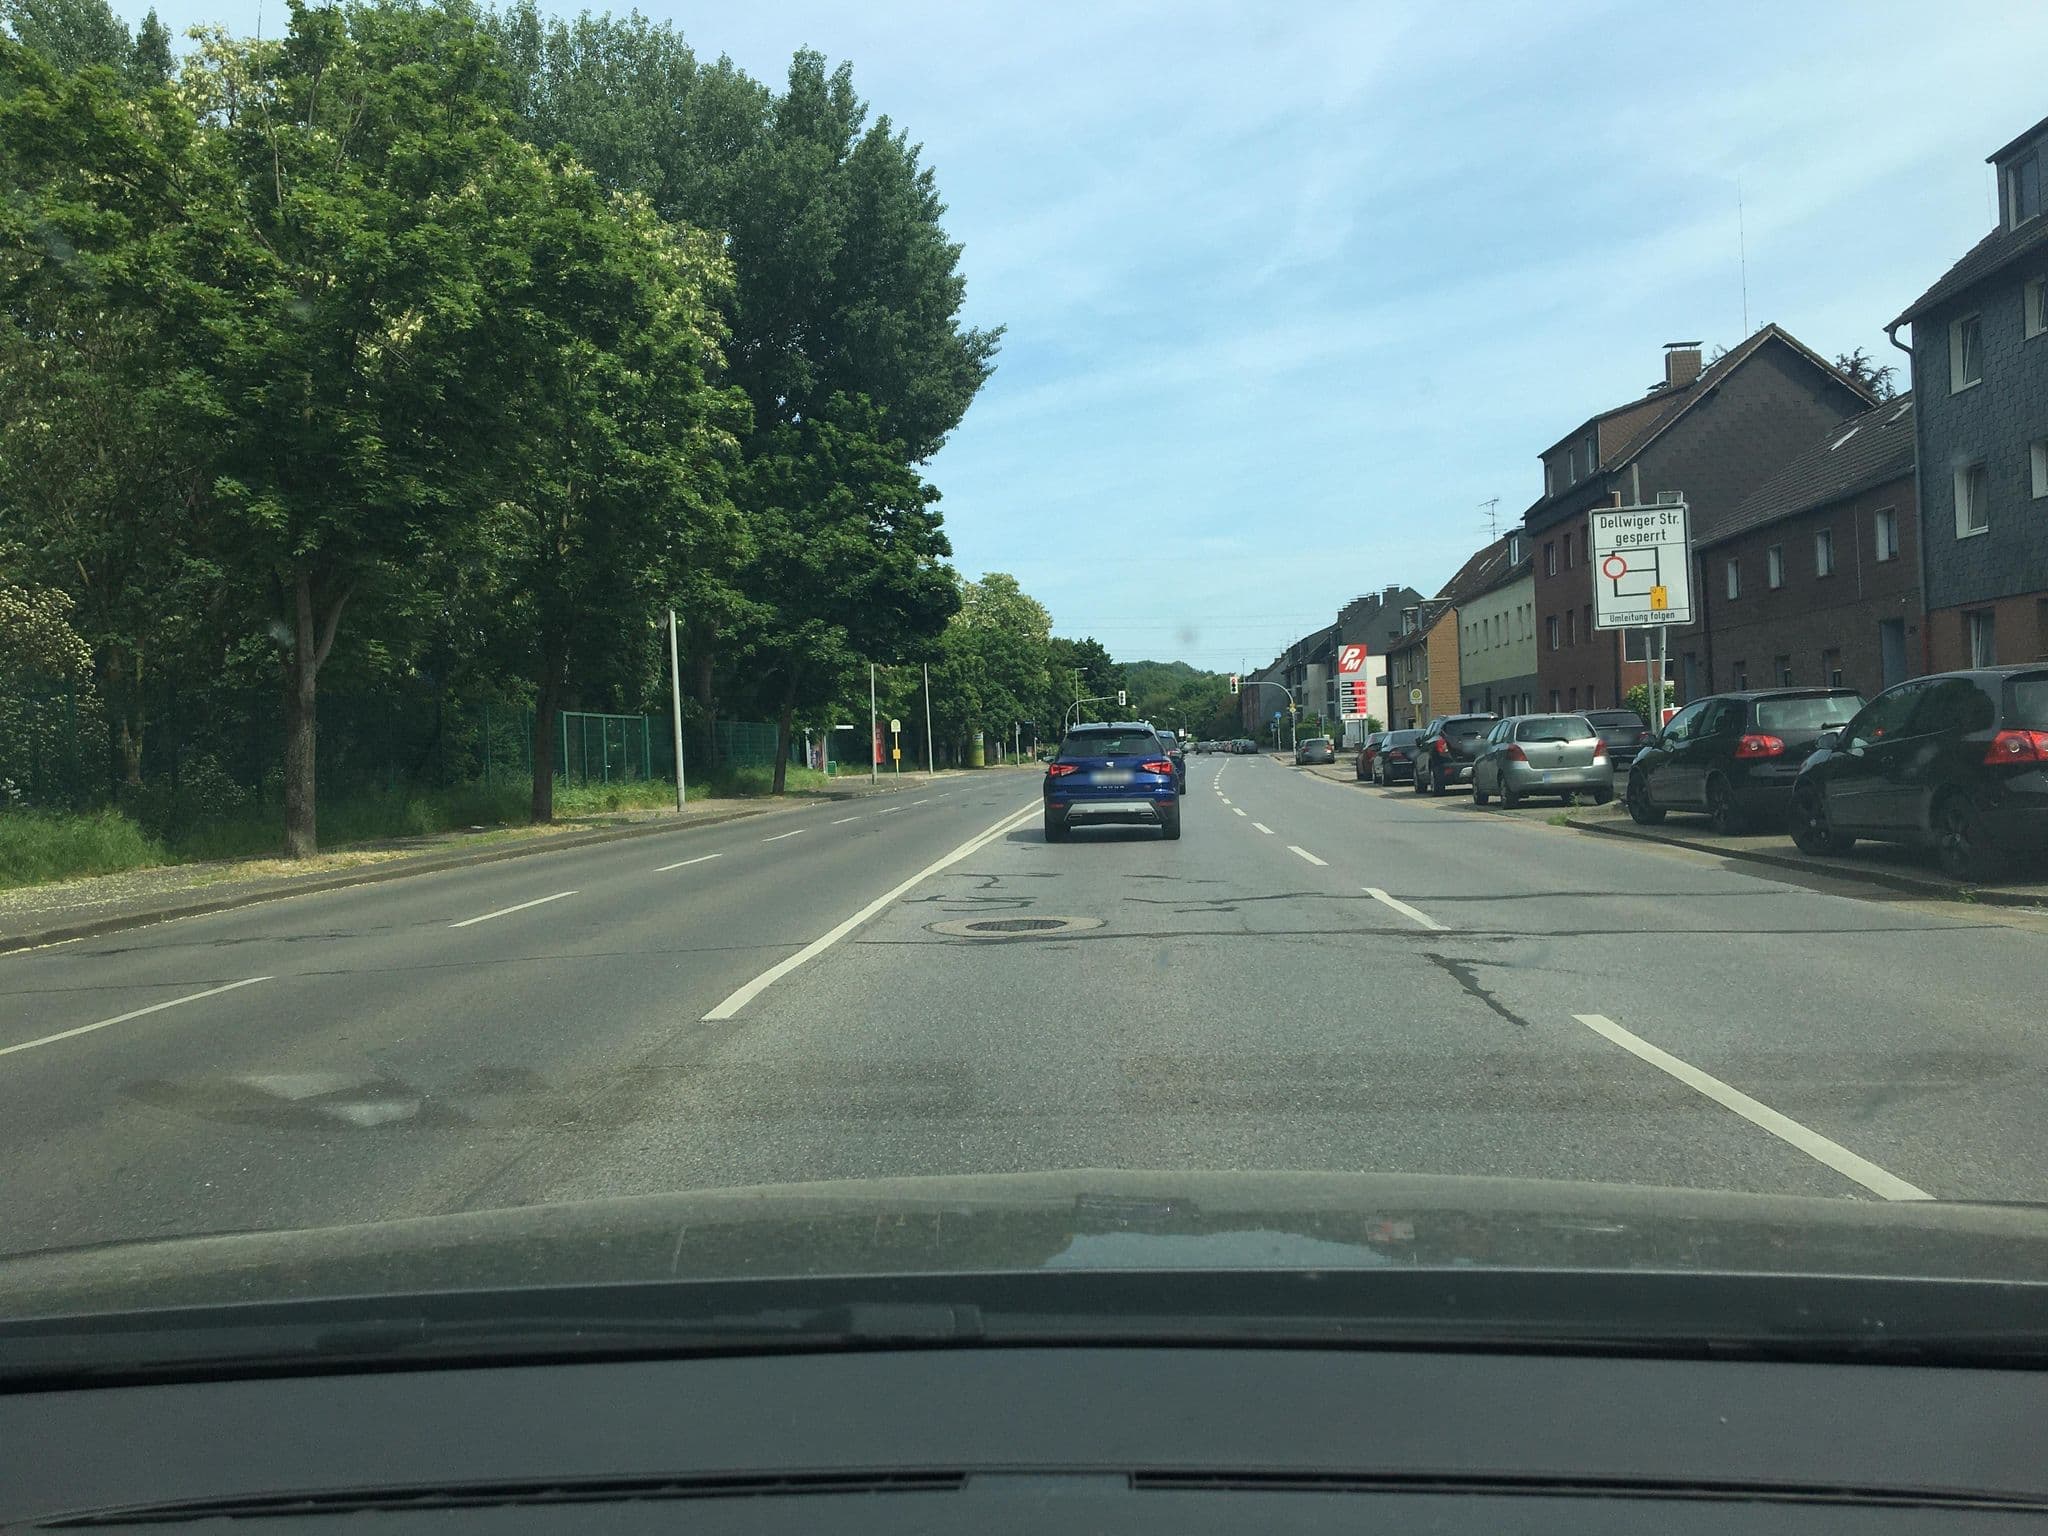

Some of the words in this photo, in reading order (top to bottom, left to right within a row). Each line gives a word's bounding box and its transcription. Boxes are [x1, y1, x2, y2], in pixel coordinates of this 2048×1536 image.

[1600, 515, 1656, 530] Dellwiger
[1659, 512, 1680, 526] Str.
[1615, 529, 1667, 546] gesperrt
[1609, 613, 1649, 623] Umleitung
[1650, 611, 1675, 622] folgen
